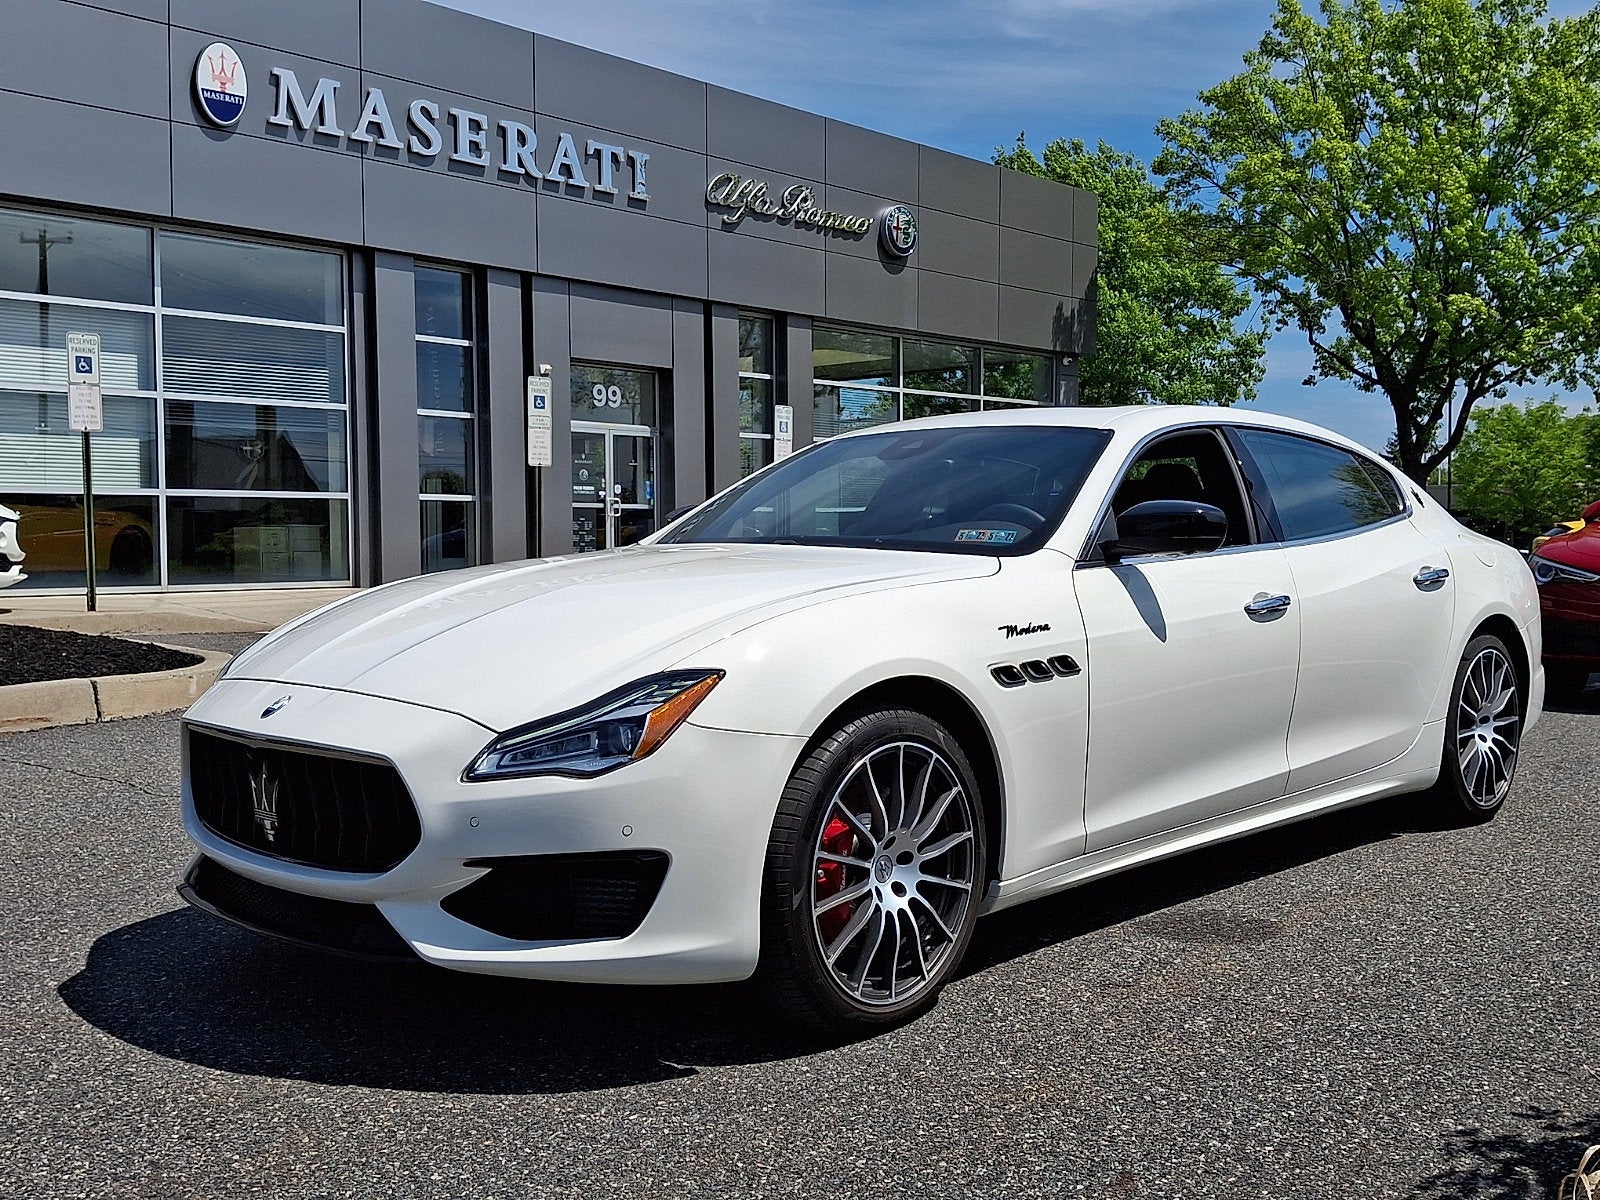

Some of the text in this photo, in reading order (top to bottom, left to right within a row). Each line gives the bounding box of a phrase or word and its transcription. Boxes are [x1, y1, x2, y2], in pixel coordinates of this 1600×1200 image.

[203, 90, 243, 105] MASERATI
[268, 66, 652, 202] MASERATI
[706, 172, 781, 223] Alfa
[780, 184, 875, 233] Romeo
[69, 337, 97, 346] RESERVED
[71, 346, 96, 354] PARKING
[592, 384, 622, 408] 99
[998, 622, 1051, 639] Modena
